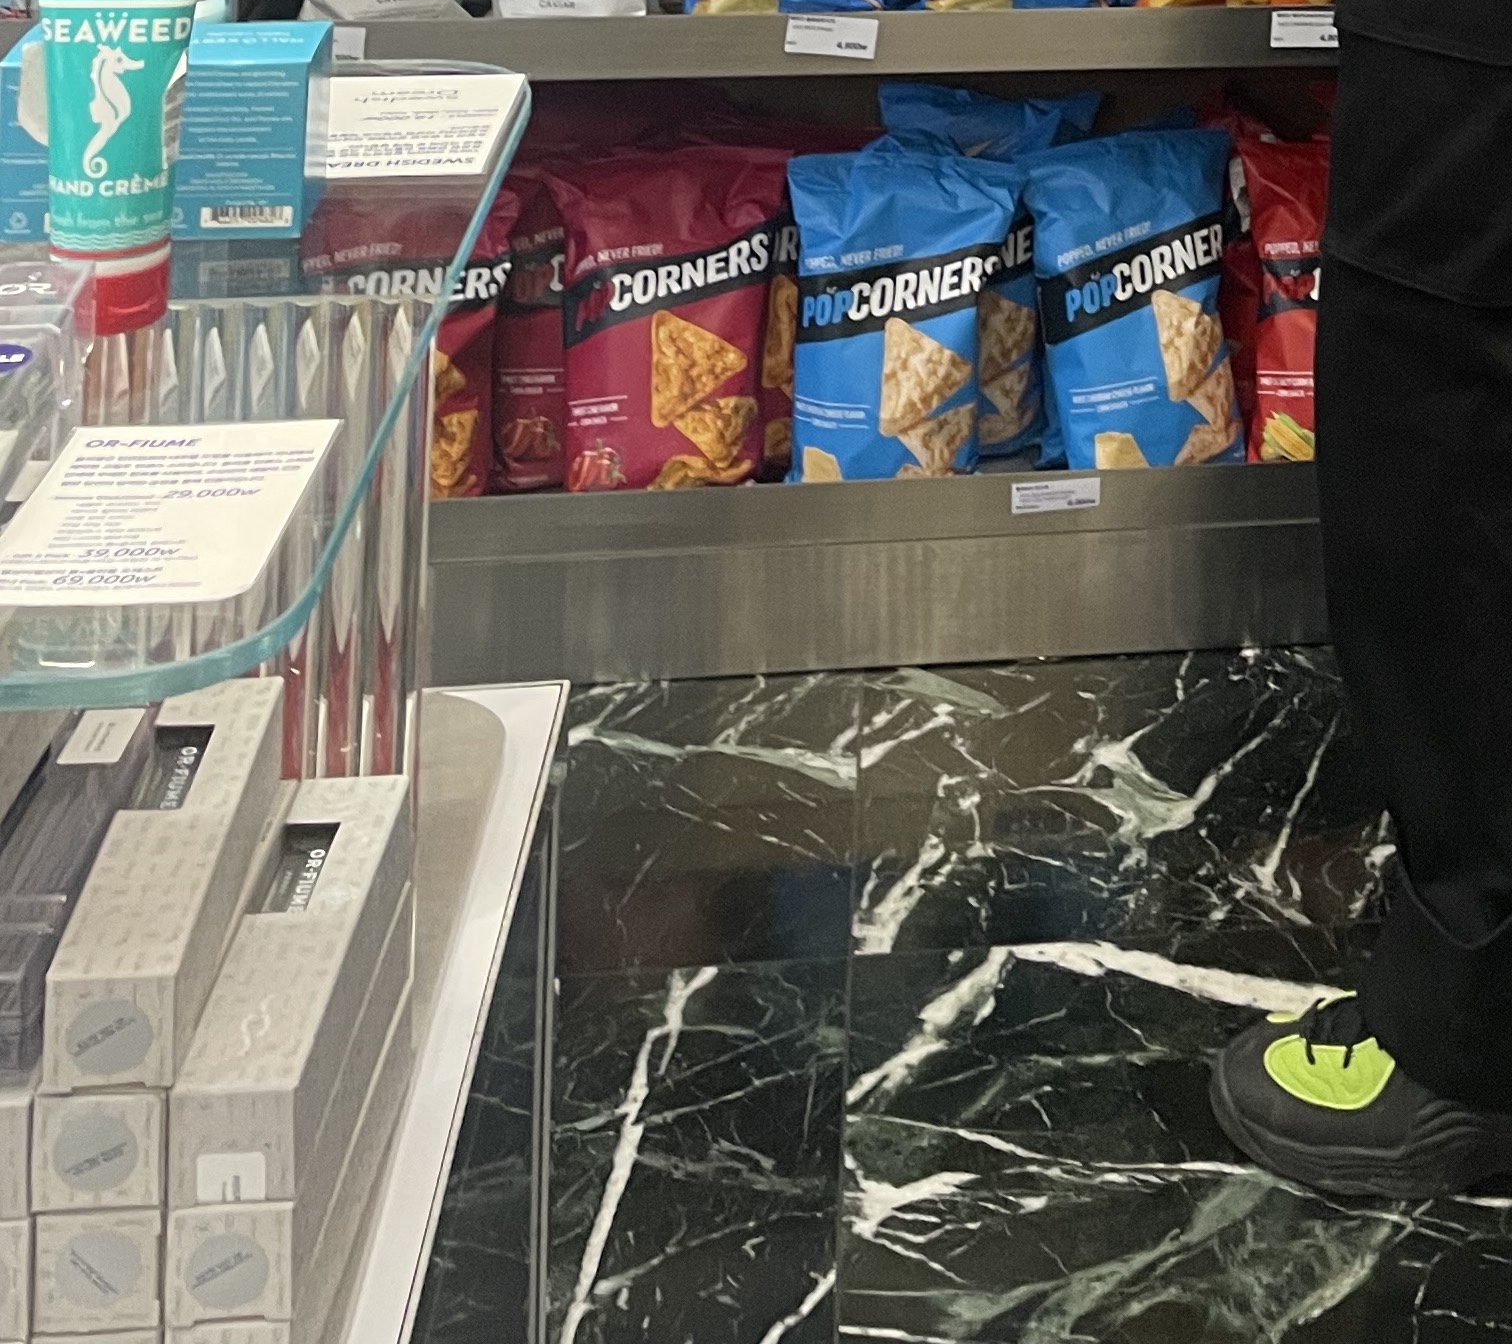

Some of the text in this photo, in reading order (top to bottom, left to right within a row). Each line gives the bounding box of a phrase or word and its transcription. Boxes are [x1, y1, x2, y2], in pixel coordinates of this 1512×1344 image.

[41, 14, 191, 43] SEAWEED
[48, 177, 95, 197] HAND
[1065, 223, 1224, 323] POPCORNER
[85, 438, 202, 449] OR-FIUME
